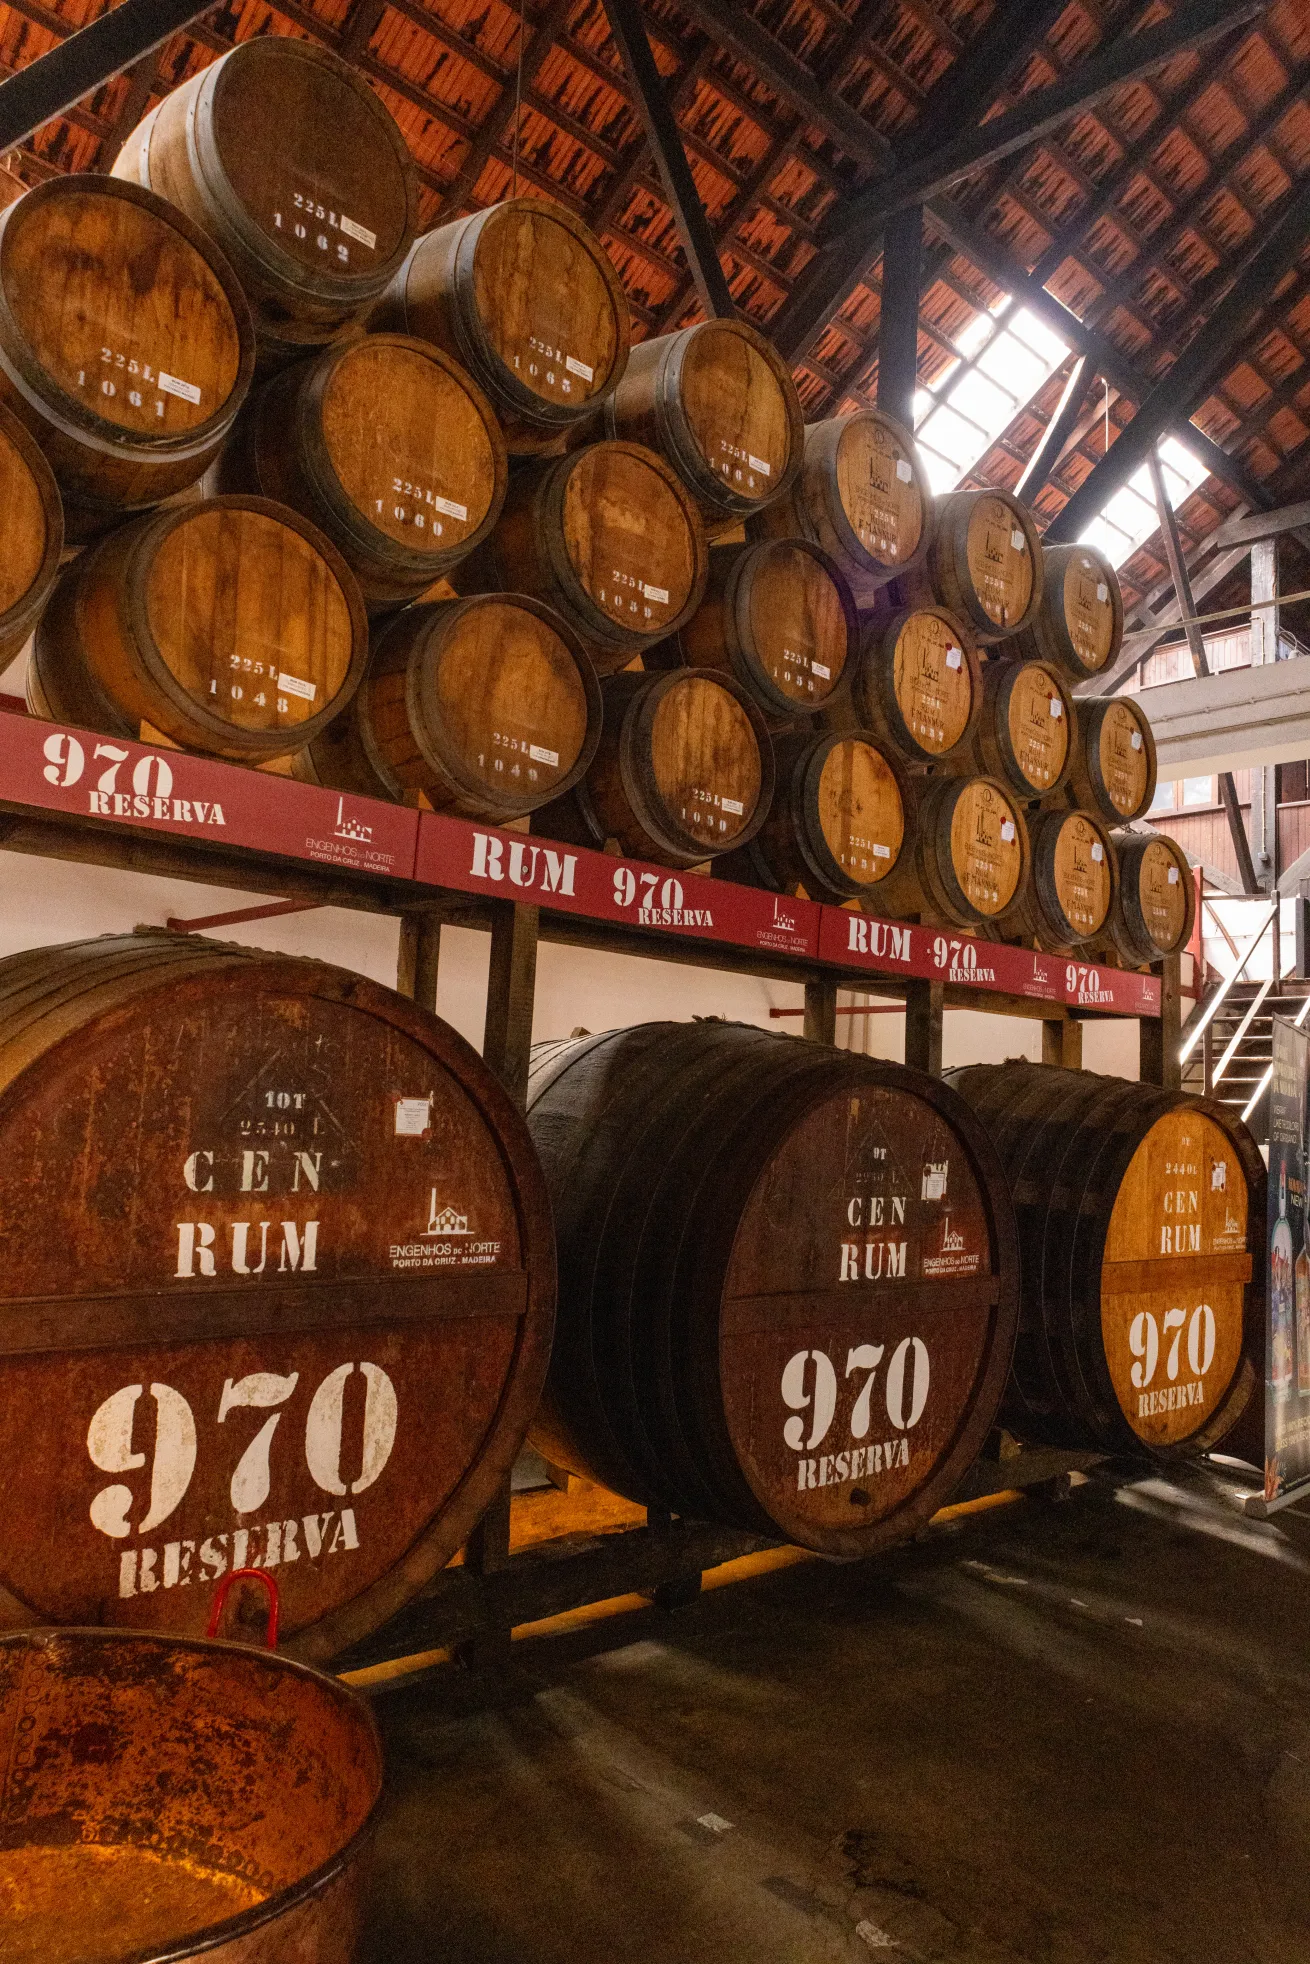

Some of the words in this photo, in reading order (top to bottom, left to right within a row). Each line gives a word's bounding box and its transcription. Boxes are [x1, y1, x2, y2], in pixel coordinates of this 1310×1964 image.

[293, 193, 339, 229] 225L
[529, 336, 563, 364] 225L
[101, 347, 155, 383] 225L
[721, 440, 748, 462] 225L
[392, 477, 434, 505] 225L
[874, 509, 896, 527] 225L
[612, 569, 645, 592] 225L
[229, 654, 278, 681] 225L
[783, 649, 808, 668] 225L
[493, 732, 529, 754] 225L
[43, 733, 173, 798] 970
[88, 790, 226, 825] RESERVA
[692, 788, 720, 806] 225L
[305, 837, 358, 857] ENGENHOS
[365, 850, 395, 866] NORTE
[310, 850, 332, 862] PORTO
[332, 855, 342, 863] DA
[342, 857, 360, 867] CRUZ
[363, 862, 390, 873] MADEIRA
[469, 832, 578, 897] RUM
[613, 867, 684, 910] 970
[637, 907, 714, 927] RESERVA
[847, 916, 912, 962] RUM
[933, 937, 977, 969] 970
[949, 968, 996, 982] RESERVA
[1065, 964, 1100, 993] 970
[1077, 990, 1114, 1004] RESERVA
[183, 1150, 323, 1192] CEN
[847, 1196, 906, 1227] CEN
[1164, 1190, 1198, 1213] CEN
[173, 1221, 320, 1278] RUM
[389, 1243, 452, 1258] ENGENHOS
[464, 1241, 501, 1254] NORTE
[1160, 1224, 1201, 1254] RUM
[393, 1258, 421, 1268] PORTO
[422, 1257, 434, 1267] DA
[434, 1257, 456, 1266] CRUZ
[461, 1255, 496, 1265] MADEIRA
[838, 1242, 908, 1282] RUM
[924, 1258, 955, 1268] ENGENHOS
[960, 1254, 979, 1264] NORTE
[1129, 1304, 1216, 1389] 970
[781, 1336, 930, 1451] 970
[1138, 1380, 1204, 1418] RESERVA
[87, 1361, 398, 1539] 970
[797, 1438, 909, 1492] RESERVA
[119, 1508, 360, 1599] RESERVA
